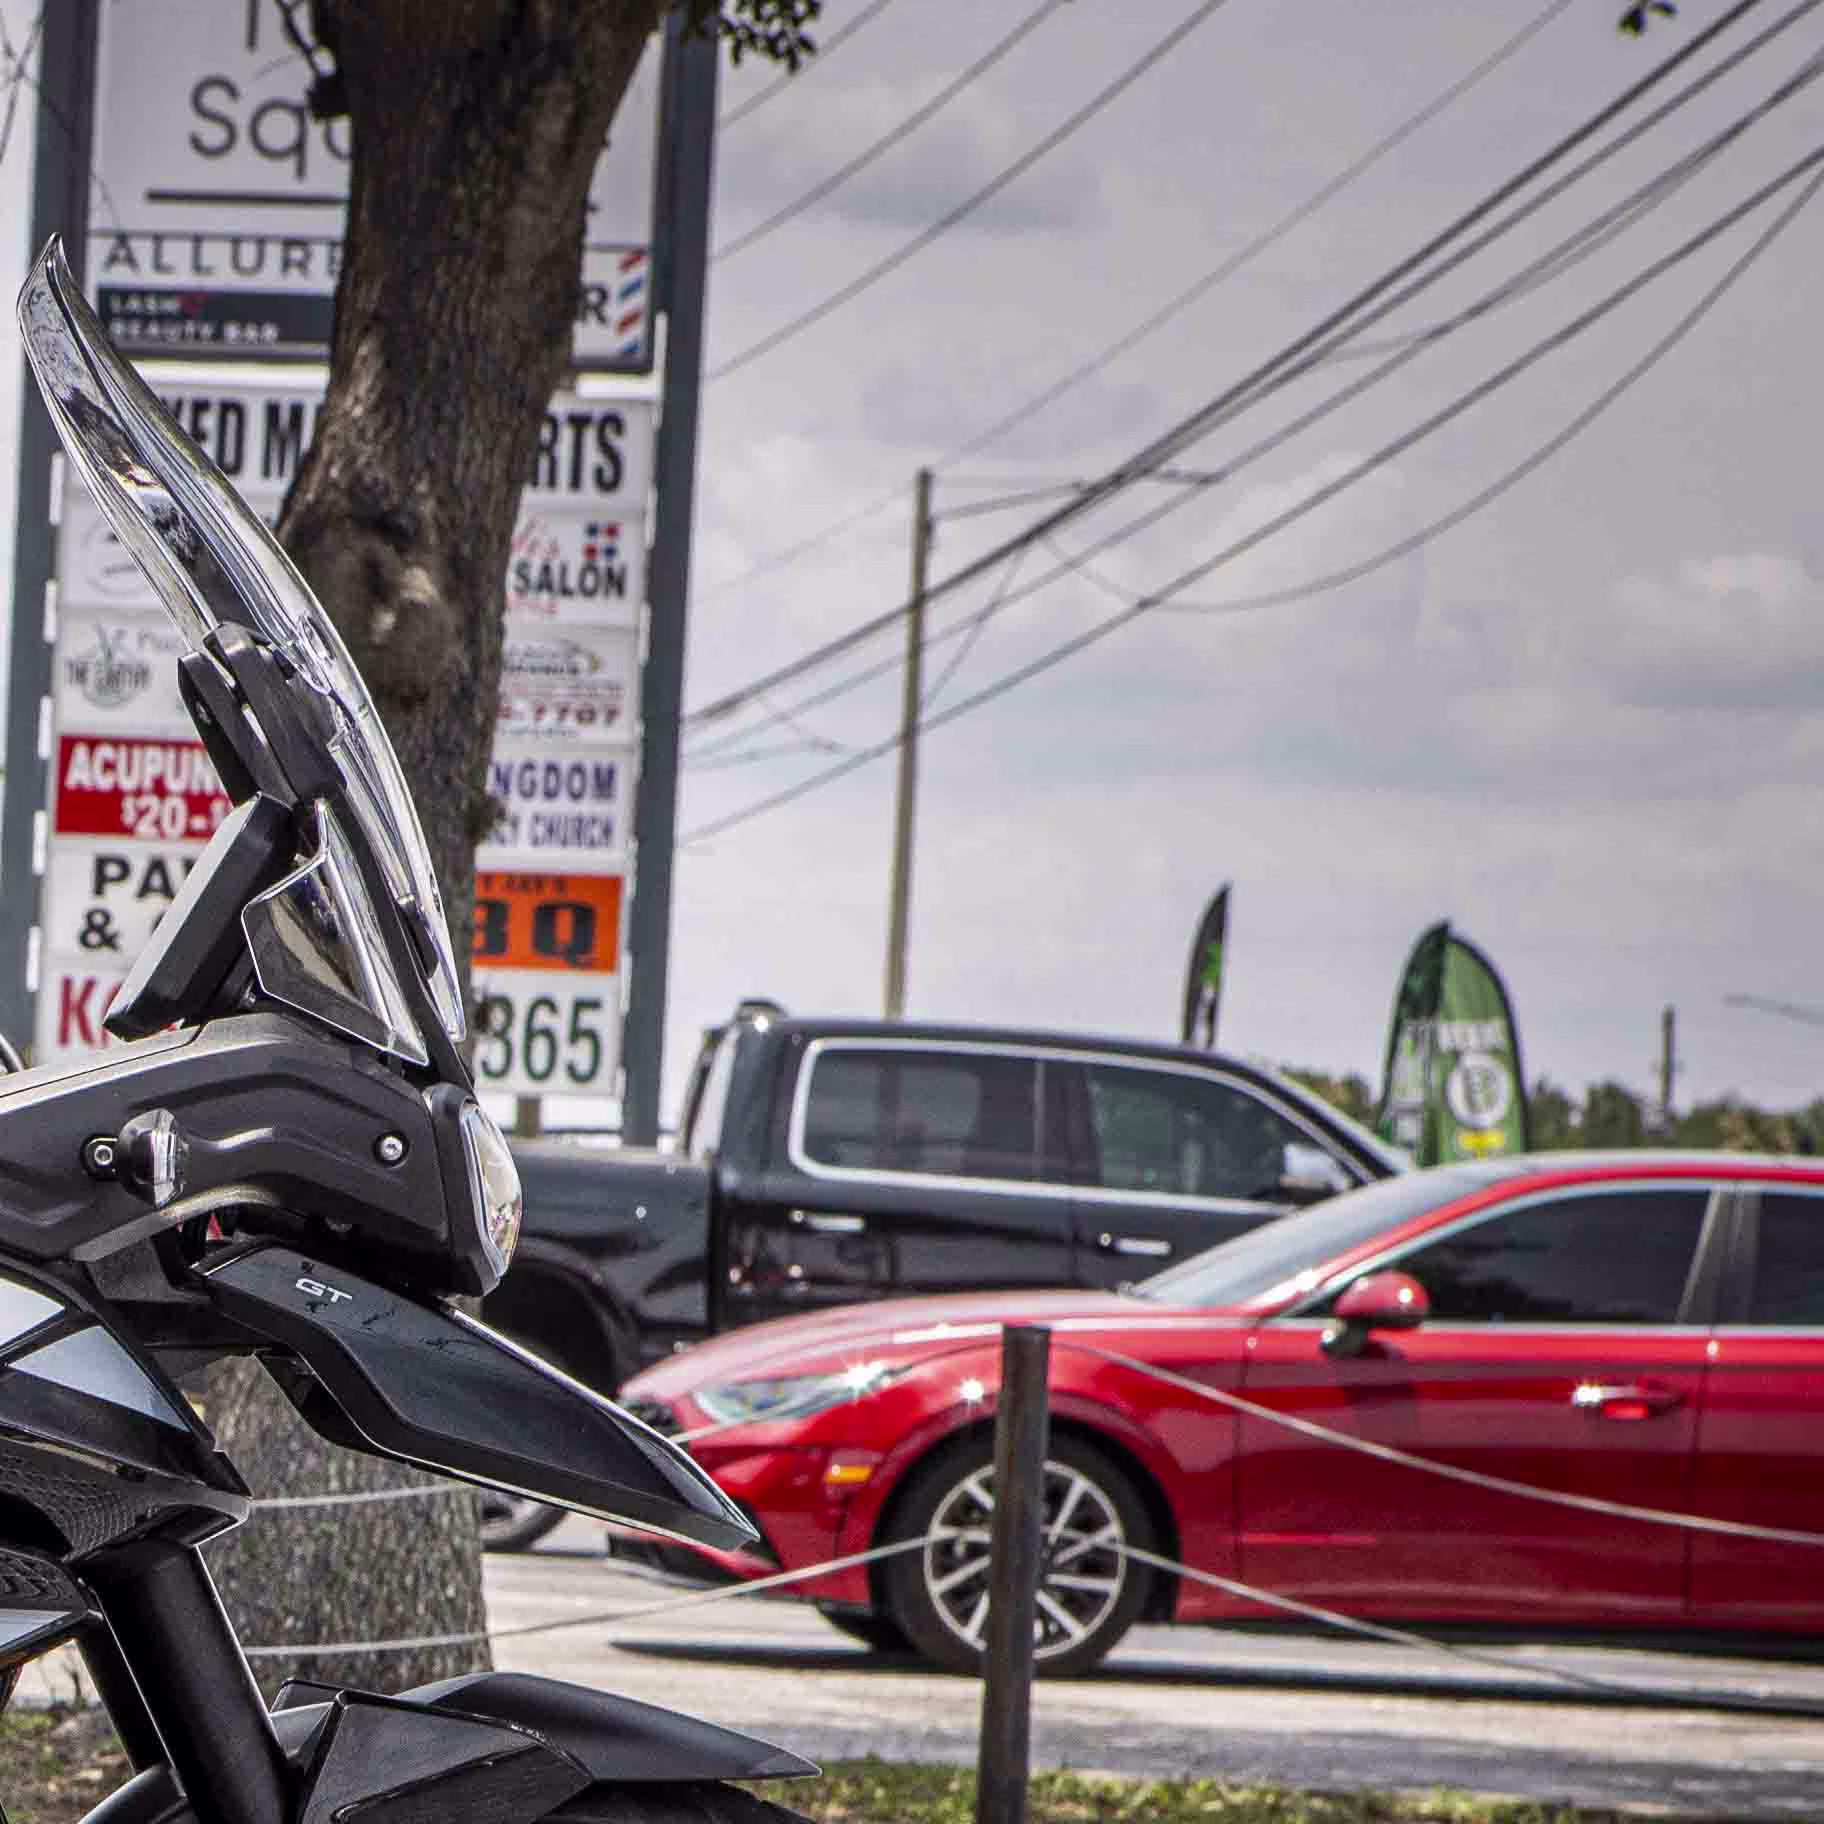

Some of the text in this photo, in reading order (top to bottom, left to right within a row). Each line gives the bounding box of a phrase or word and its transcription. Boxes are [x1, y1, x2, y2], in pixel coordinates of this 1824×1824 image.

[260, 396, 328, 478] M
[528, 413, 626, 493] RTS
[513, 560, 626, 597] SALON
[64, 741, 224, 794] ACUPUN
[493, 761, 617, 800] NGDOM
[93, 857, 195, 900] PA
[295, 1277, 353, 1304] GT
